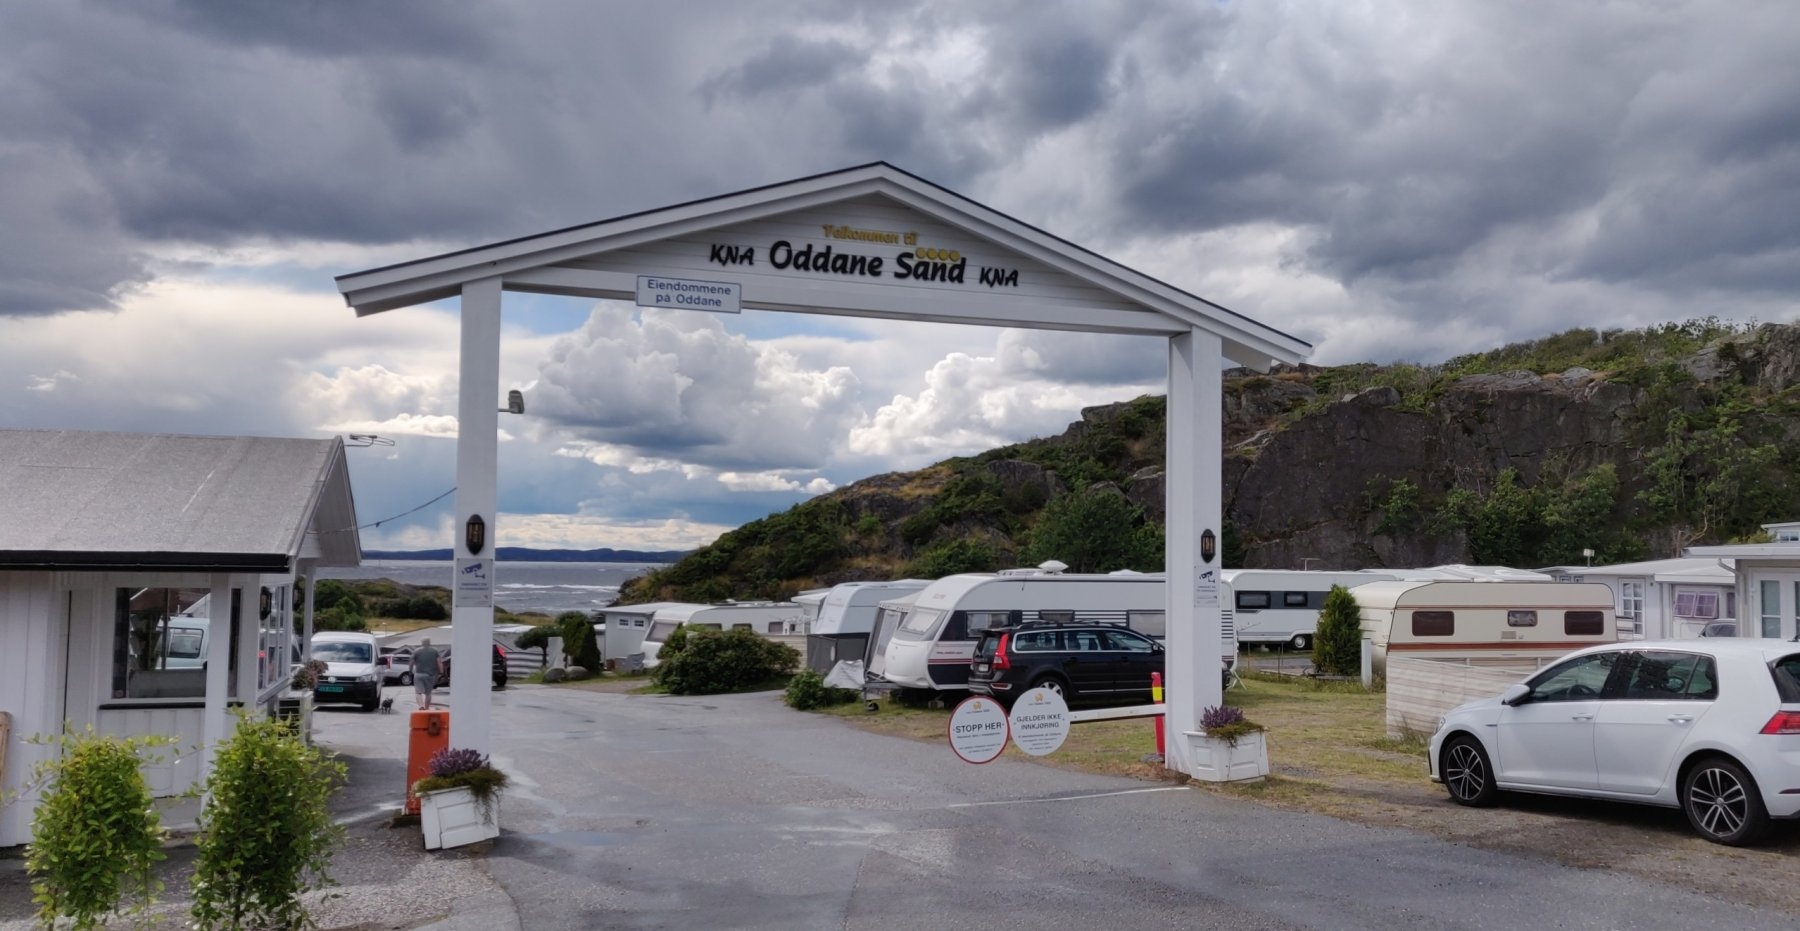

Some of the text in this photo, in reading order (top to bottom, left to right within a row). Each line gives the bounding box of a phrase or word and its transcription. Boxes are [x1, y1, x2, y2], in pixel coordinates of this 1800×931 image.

[709, 239, 1019, 288] KNA Oddane Sand KNA
[647, 279, 731, 295] Eiendommene
[656, 294, 722, 307] på Oddane
[1016, 714, 1046, 722] GJELDER
[955, 721, 1002, 733] STOPP HER
[1020, 722, 1060, 730] INNKJØRING
